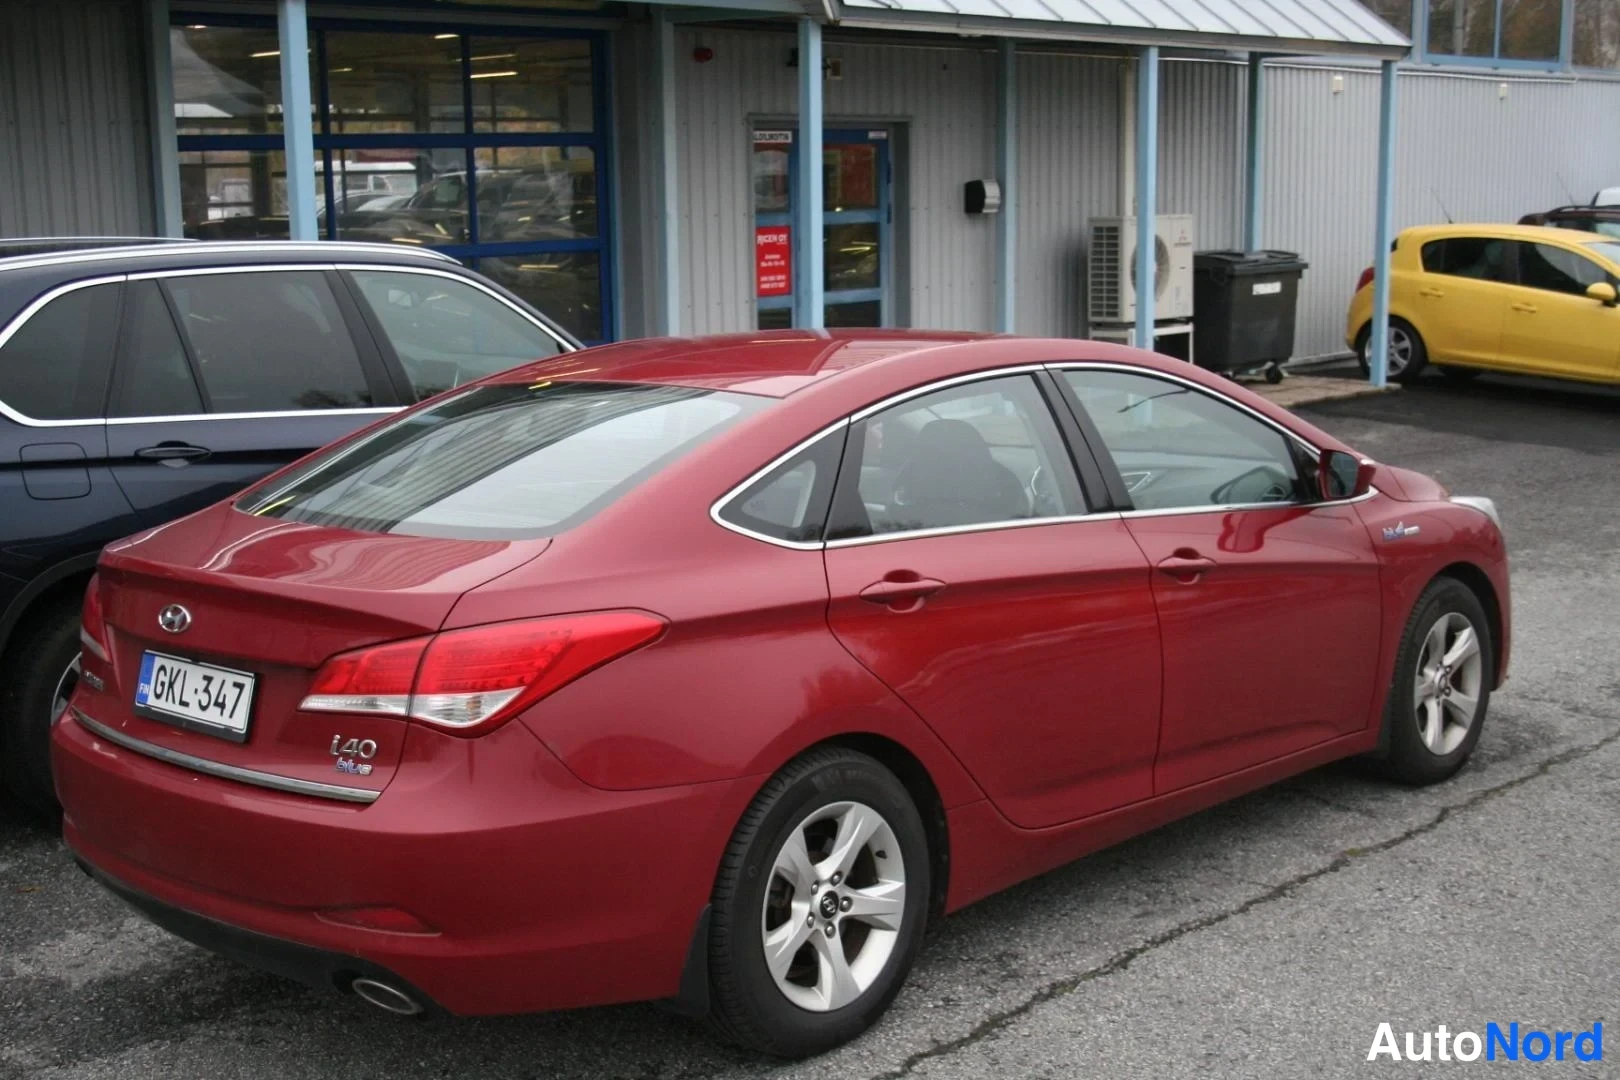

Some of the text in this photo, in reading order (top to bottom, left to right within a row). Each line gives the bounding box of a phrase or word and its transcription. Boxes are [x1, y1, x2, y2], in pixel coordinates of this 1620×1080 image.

[140, 683, 150, 695] FIN
[153, 664, 246, 720] GKL-347
[330, 734, 377, 759] i40
